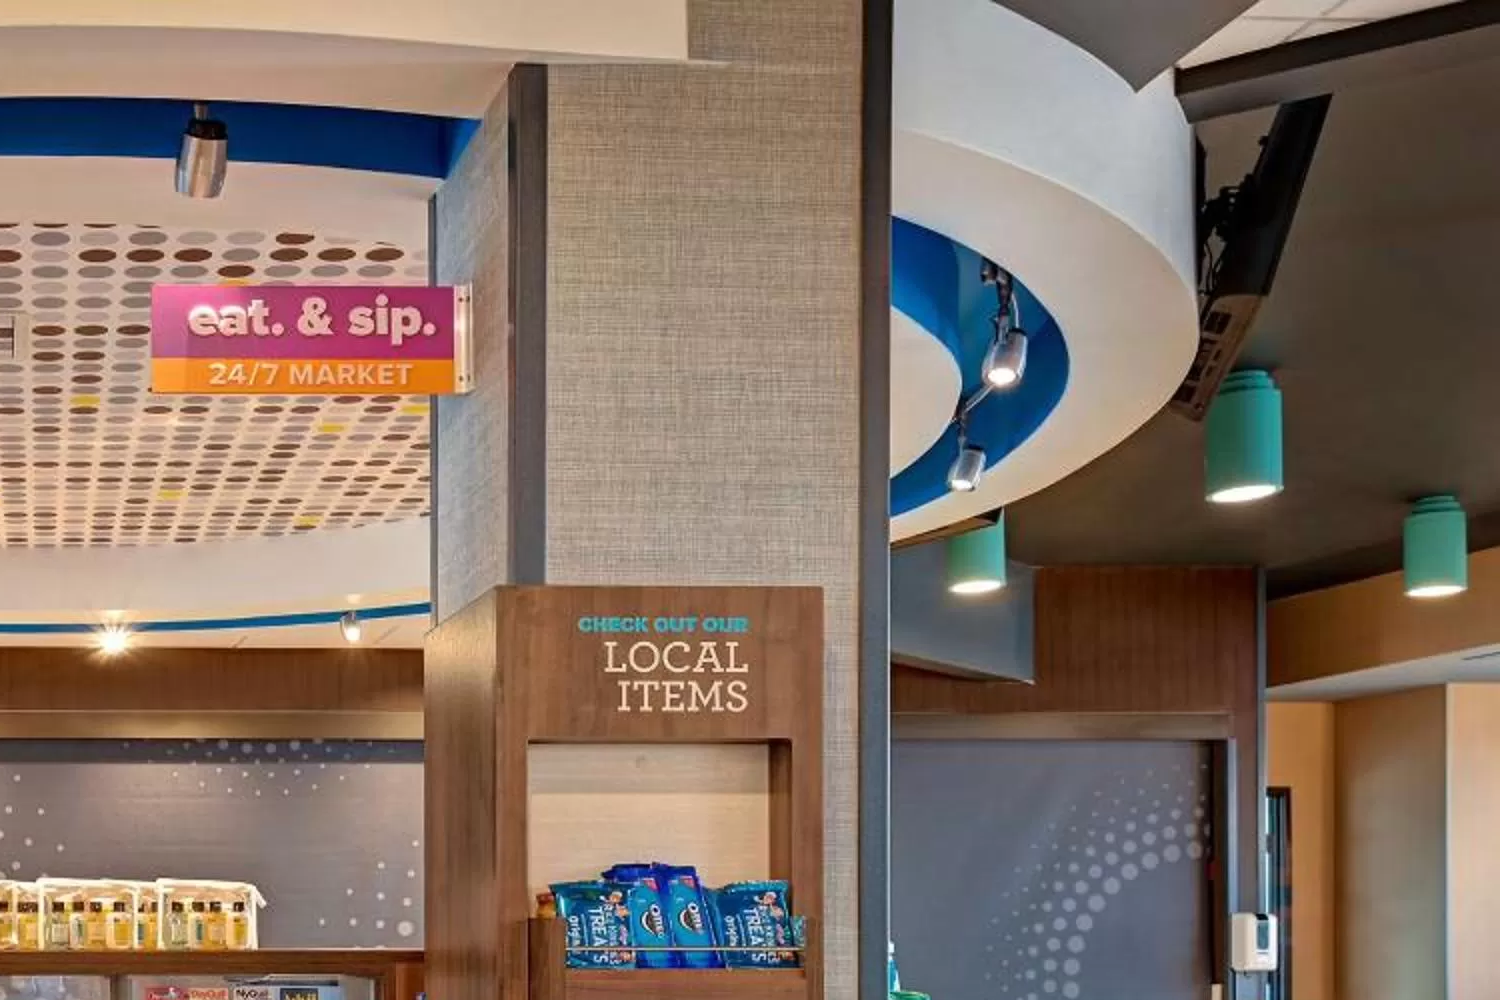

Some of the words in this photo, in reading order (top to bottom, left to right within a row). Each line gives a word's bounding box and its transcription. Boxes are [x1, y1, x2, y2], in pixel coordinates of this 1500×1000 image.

[188, 299, 284, 336] eat.
[297, 297, 333, 336] &
[349, 294, 436, 345] sip.
[209, 363, 279, 385] 24/7
[290, 363, 412, 385] MARKET
[579, 616, 649, 632] CHECK
[654, 616, 698, 632] OUT
[703, 616, 749, 632] OUR
[604, 641, 748, 673] LOCAL
[617, 680, 749, 712] ITEMS
